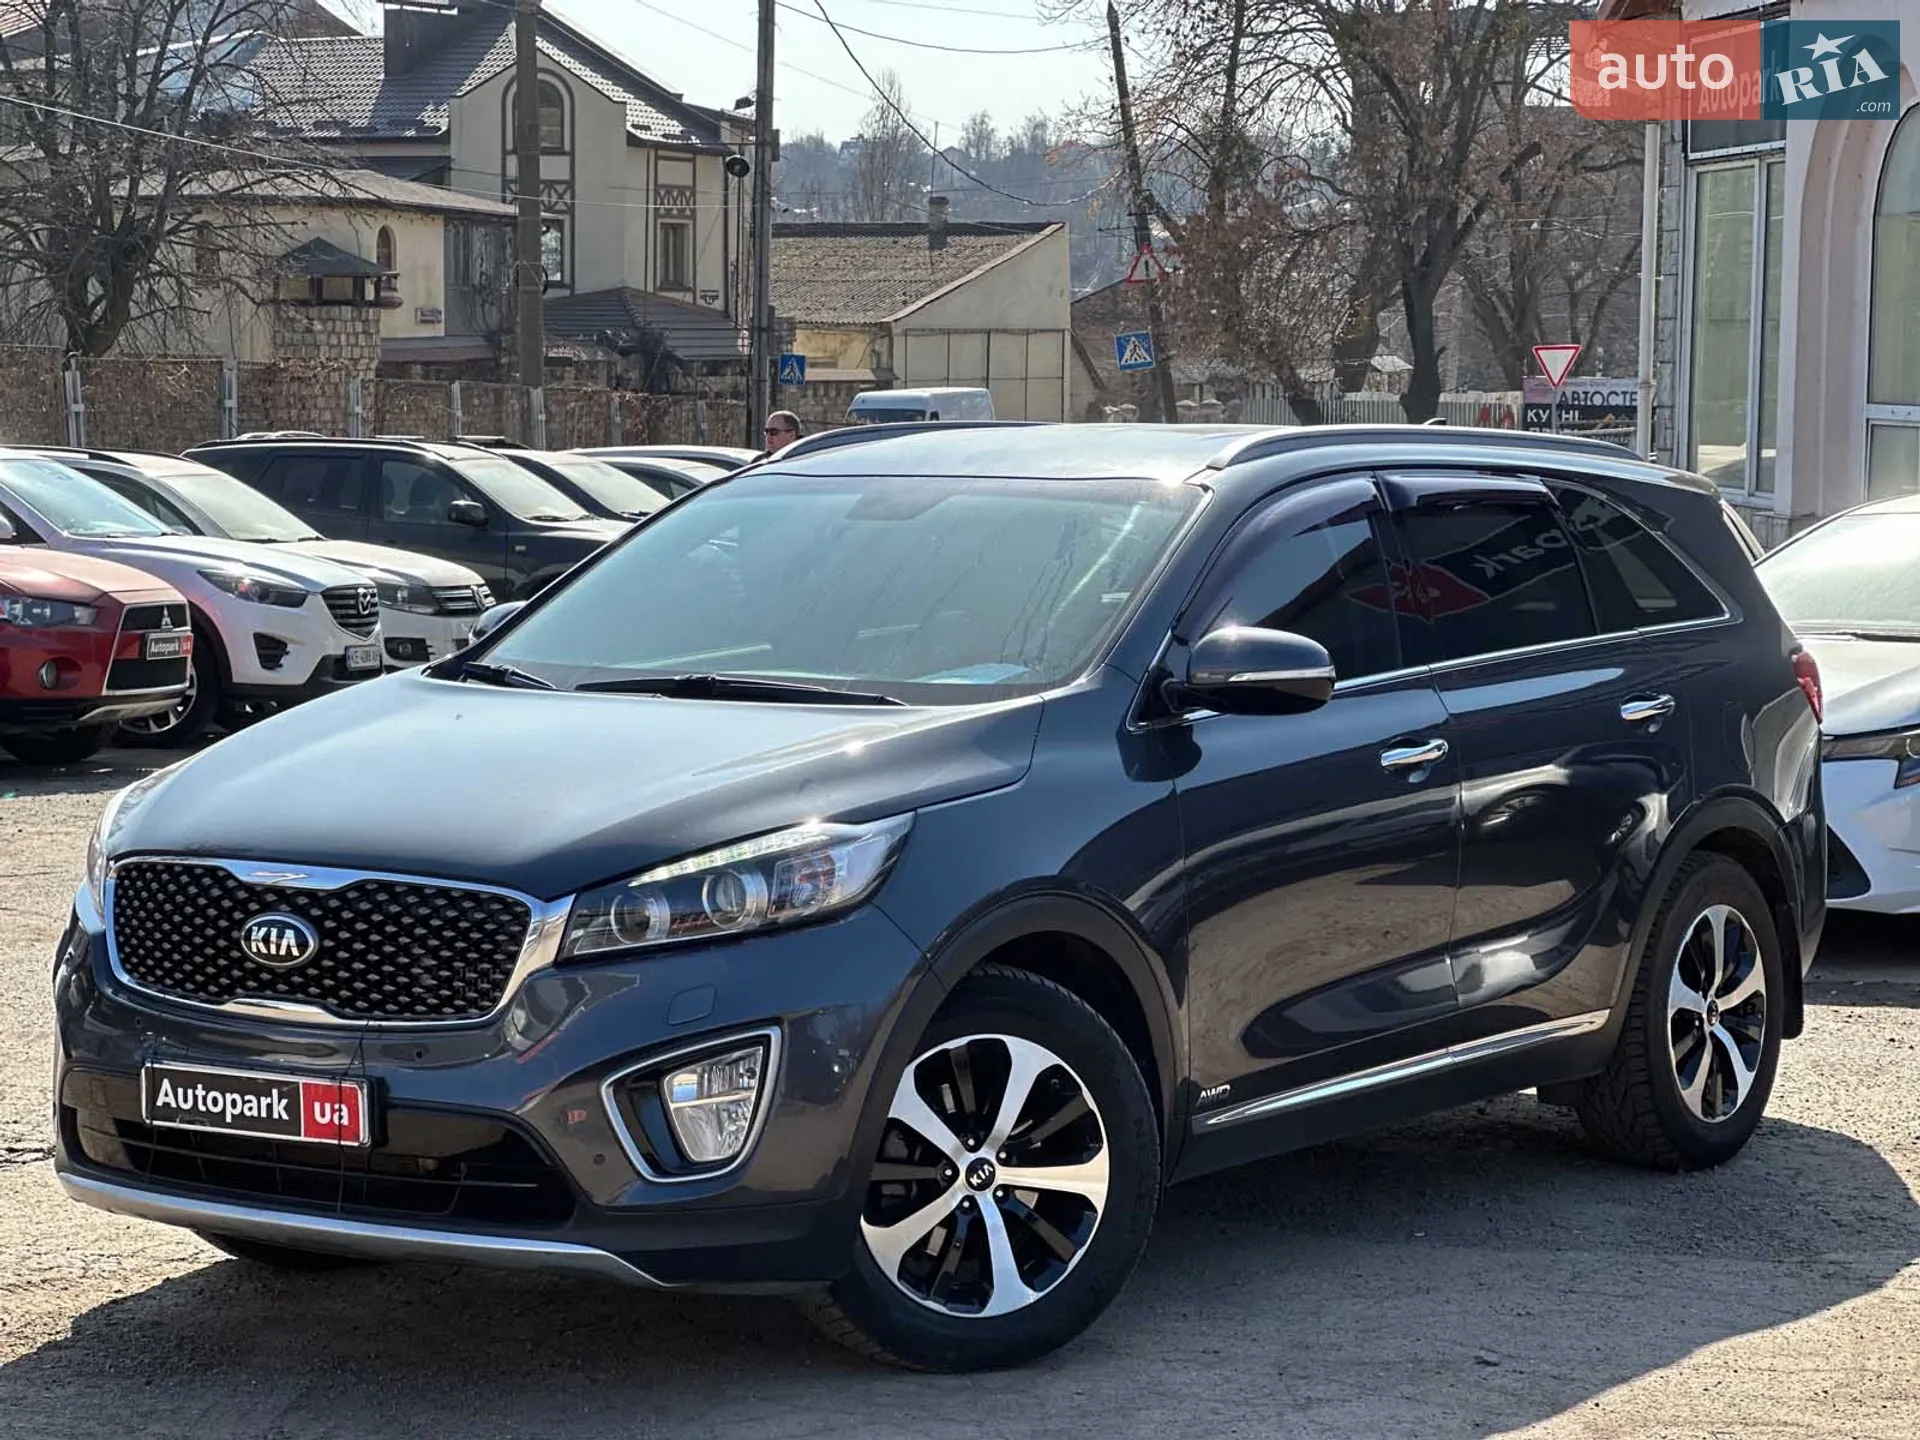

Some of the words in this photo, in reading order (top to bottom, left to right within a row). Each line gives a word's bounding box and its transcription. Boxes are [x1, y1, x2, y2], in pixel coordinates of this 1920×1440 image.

[1527, 409, 1579, 422] КУНІ
[250, 926, 300, 956] KIA
[156, 1078, 289, 1123] Autopark
[314, 1101, 349, 1126] ua
[1196, 1084, 1231, 1107] AWD
[969, 1163, 994, 1187] KIA
